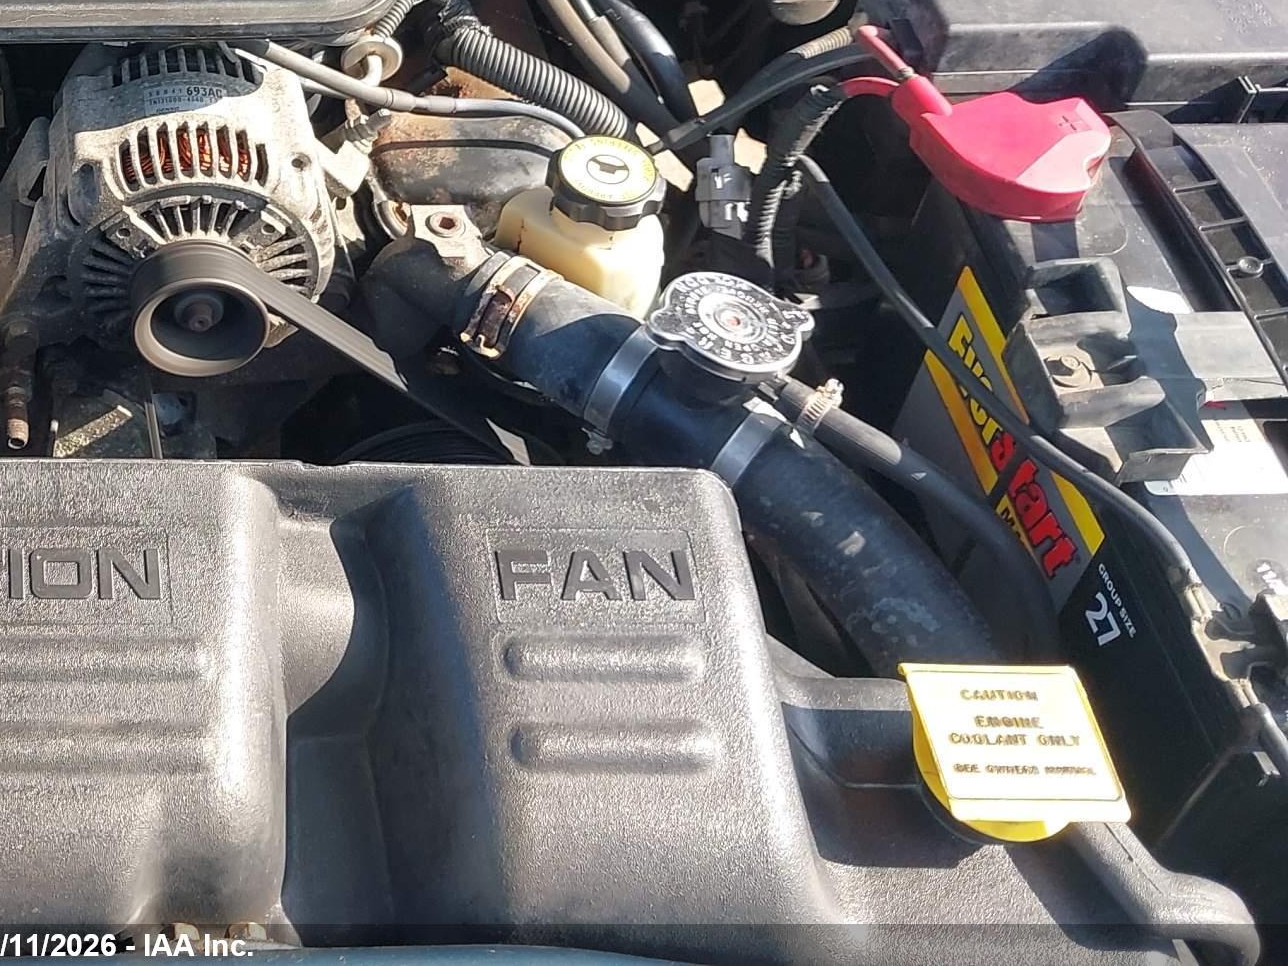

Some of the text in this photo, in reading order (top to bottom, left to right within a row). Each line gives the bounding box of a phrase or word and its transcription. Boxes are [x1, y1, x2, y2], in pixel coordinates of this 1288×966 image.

[494, 550, 697, 601] FAN
[1098, 562, 1137, 639] GROUP SIZE
[1085, 592, 1122, 647] 27
[960, 689, 1039, 702] CAUTION
[974, 715, 1044, 729] ENGINE
[949, 733, 1081, 747] COOLANT ONLY
